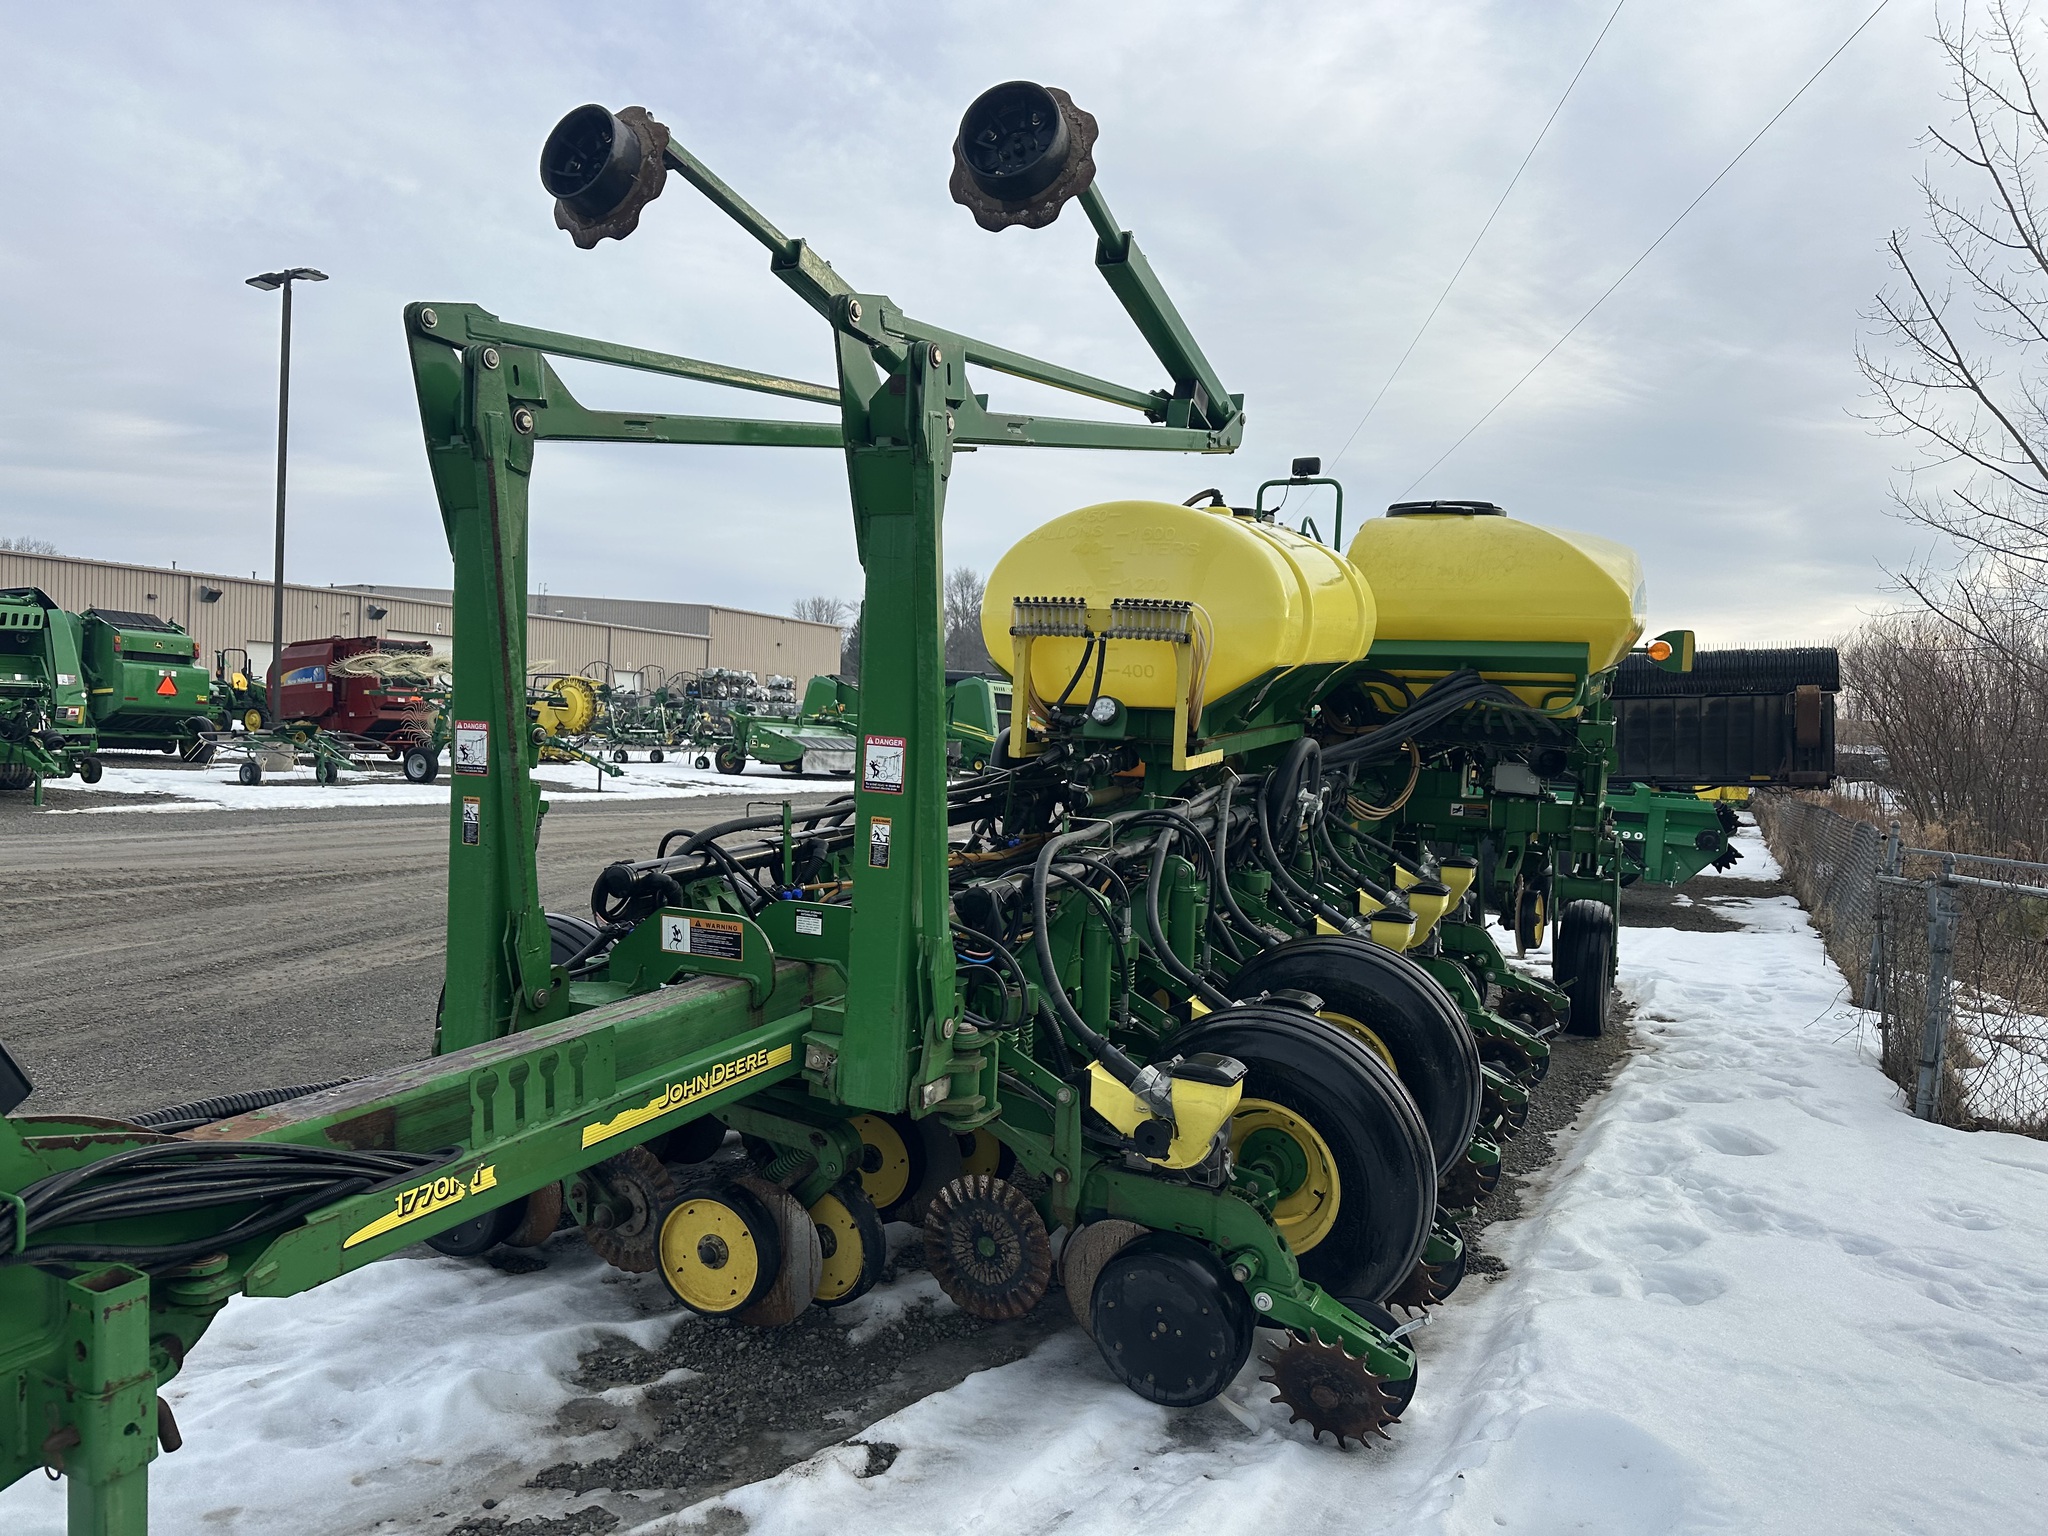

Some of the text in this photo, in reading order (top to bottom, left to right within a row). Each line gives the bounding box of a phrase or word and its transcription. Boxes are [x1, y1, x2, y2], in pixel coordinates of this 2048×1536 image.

[1025, 524, 1104, 544] GALLONS
[1129, 526, 1176, 541] 1600
[1127, 541, 1200, 557] LITERS
[1123, 577, 1169, 592] 1200
[1064, 665, 1094, 679] 10
[1121, 664, 1155, 678] 400
[463, 722, 487, 730] DANGER
[874, 738, 903, 747] DANGER
[705, 922, 738, 931] WARNING
[658, 1048, 768, 1109] JOHN DEERE
